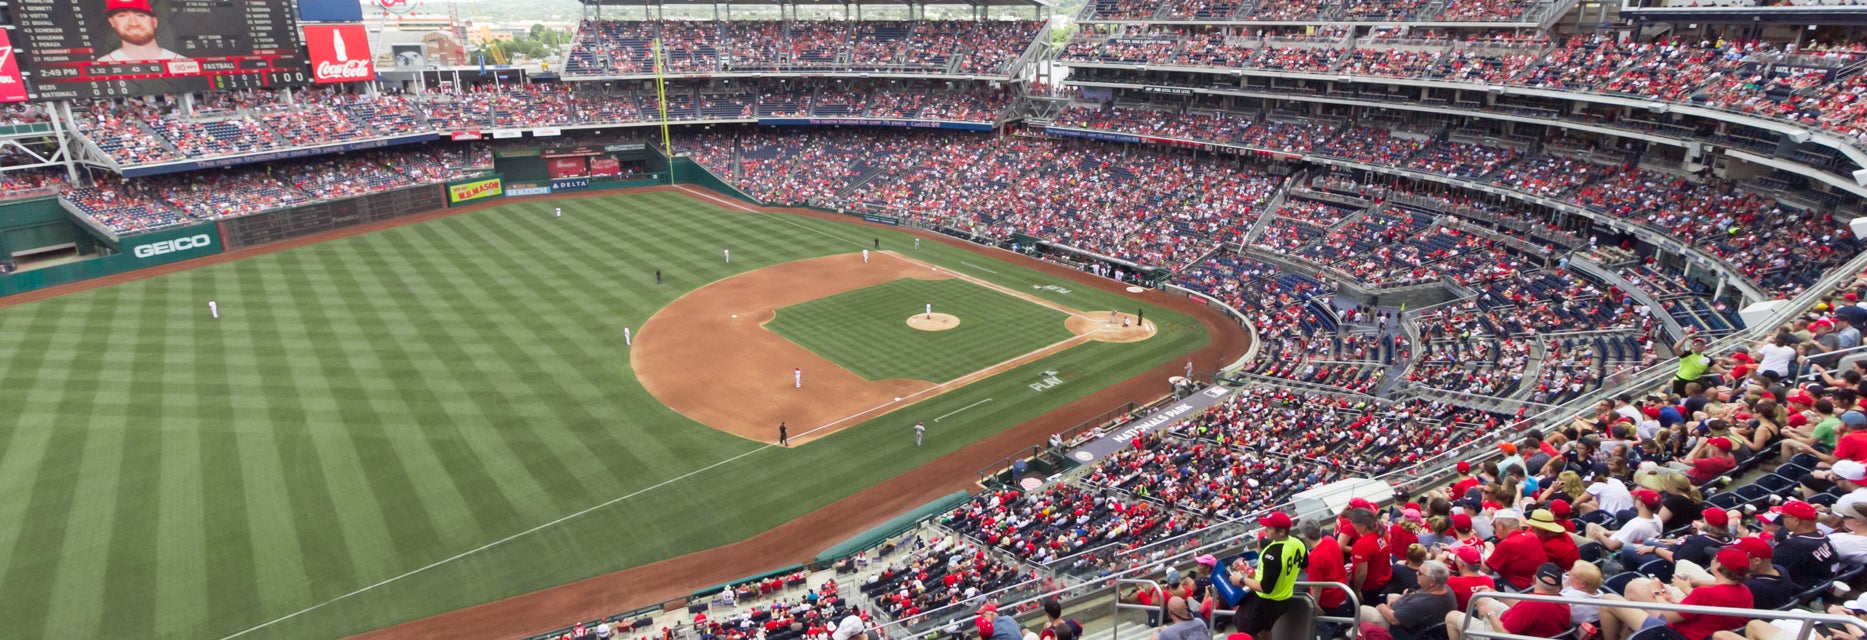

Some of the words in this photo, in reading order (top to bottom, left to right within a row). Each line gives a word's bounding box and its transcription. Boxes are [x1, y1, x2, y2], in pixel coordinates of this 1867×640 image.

[40, 69, 61, 77] 2:49
[62, 68, 78, 76] PM
[203, 62, 235, 70] FASTBALL
[91, 81, 98, 89] 5
[119, 79, 126, 88] 0
[272, 73, 278, 83] 1
[283, 73, 292, 82] 0
[295, 72, 304, 82] 0
[93, 88, 101, 96] 0
[107, 87, 115, 95] 0
[121, 86, 128, 95] 0
[196, 160, 215, 168] The
[216, 158, 242, 167] name
[244, 153, 276, 163] trusted
[277, 151, 289, 159] for
[290, 149, 309, 157] over
[322, 145, 345, 154] years
[134, 234, 211, 258] GEICO
[1028, 375, 1064, 392] PLAY
[1112, 414, 1169, 443] NATIONALS
[1164, 402, 1194, 418] PARK
[1812, 543, 1832, 562] POP
